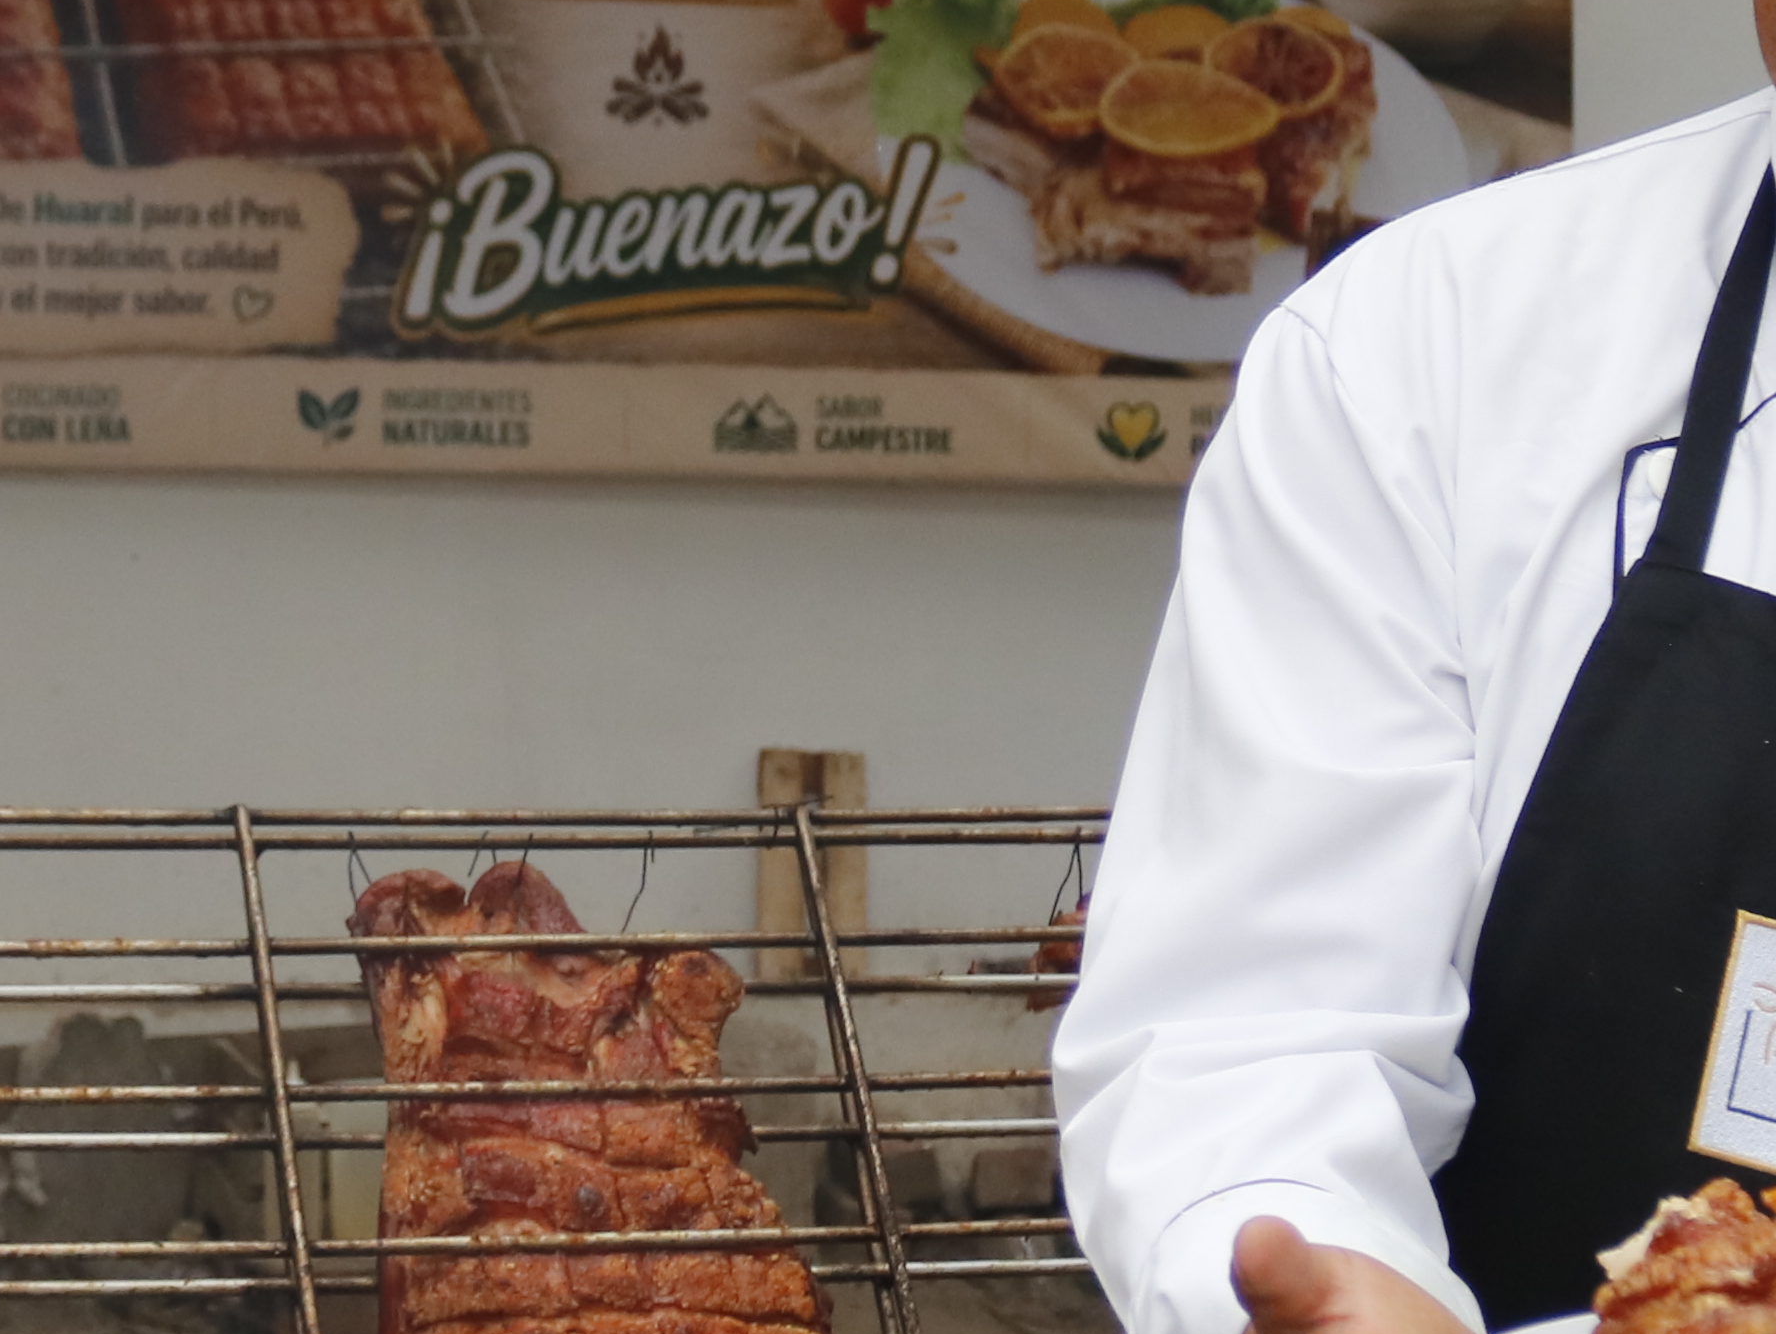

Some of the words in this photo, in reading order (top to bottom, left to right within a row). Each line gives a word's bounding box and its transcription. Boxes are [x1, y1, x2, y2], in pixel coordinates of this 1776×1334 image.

[33, 194, 134, 226] Huaral
[140, 201, 201, 231] para
[208, 198, 233, 227] el
[401, 139, 939, 325] ¡Buenazo!
[181, 241, 279, 273] calidad
[11, 284, 35, 312] el
[44, 285, 126, 318] mejor
[2, 415, 57, 442] CON
[65, 413, 133, 443] LEÑA
[383, 418, 530, 448] NATURALES
[814, 425, 952, 454] CAMPESTRE
